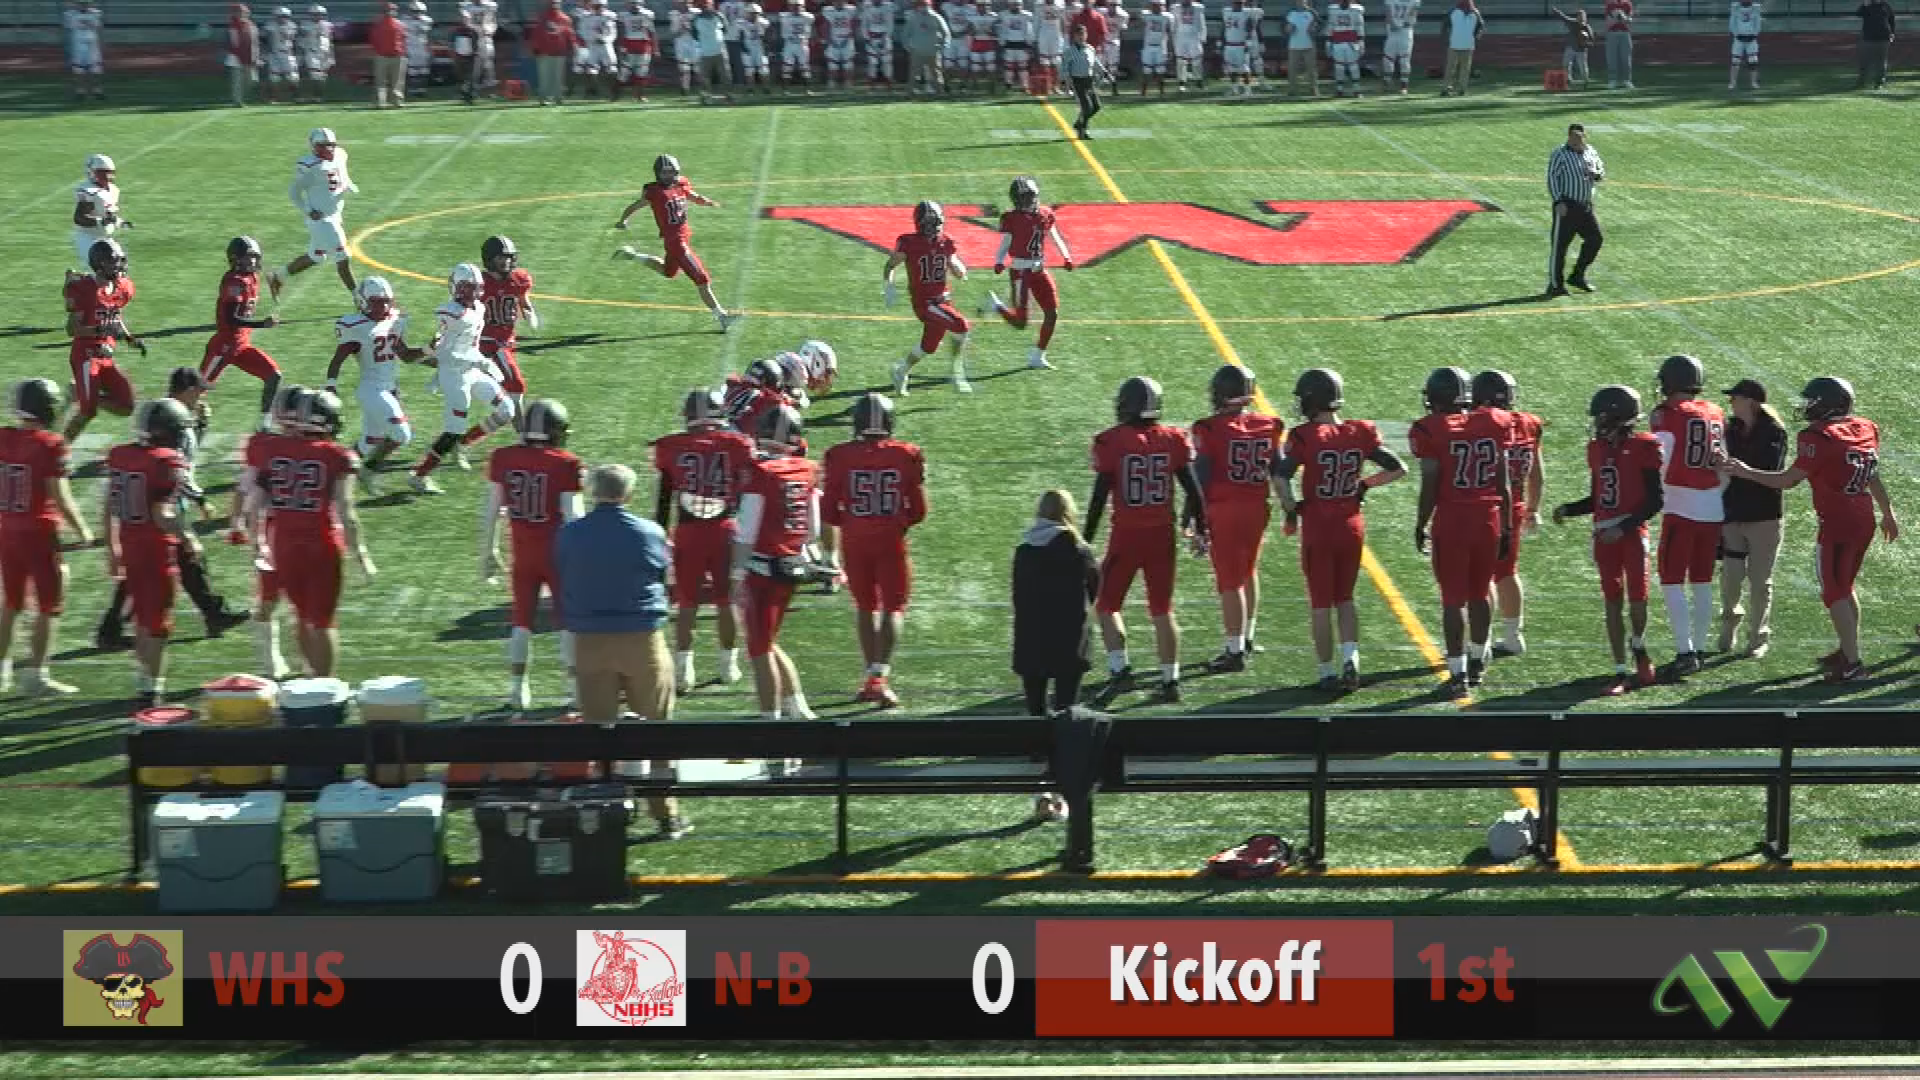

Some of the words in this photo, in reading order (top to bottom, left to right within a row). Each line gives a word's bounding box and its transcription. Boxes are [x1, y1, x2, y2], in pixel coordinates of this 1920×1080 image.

[1027, 227, 1042, 257] 4
[899, 254, 948, 284] 12
[270, 457, 327, 513] 22
[675, 451, 731, 499] 34
[1121, 454, 1171, 507] 65
[1228, 438, 1272, 484] 55
[1316, 448, 1363, 498] 32
[1449, 438, 1498, 489] 72
[504, 469, 549, 522] 31
[848, 468, 902, 516] 56
[1600, 465, 1620, 508] 3
